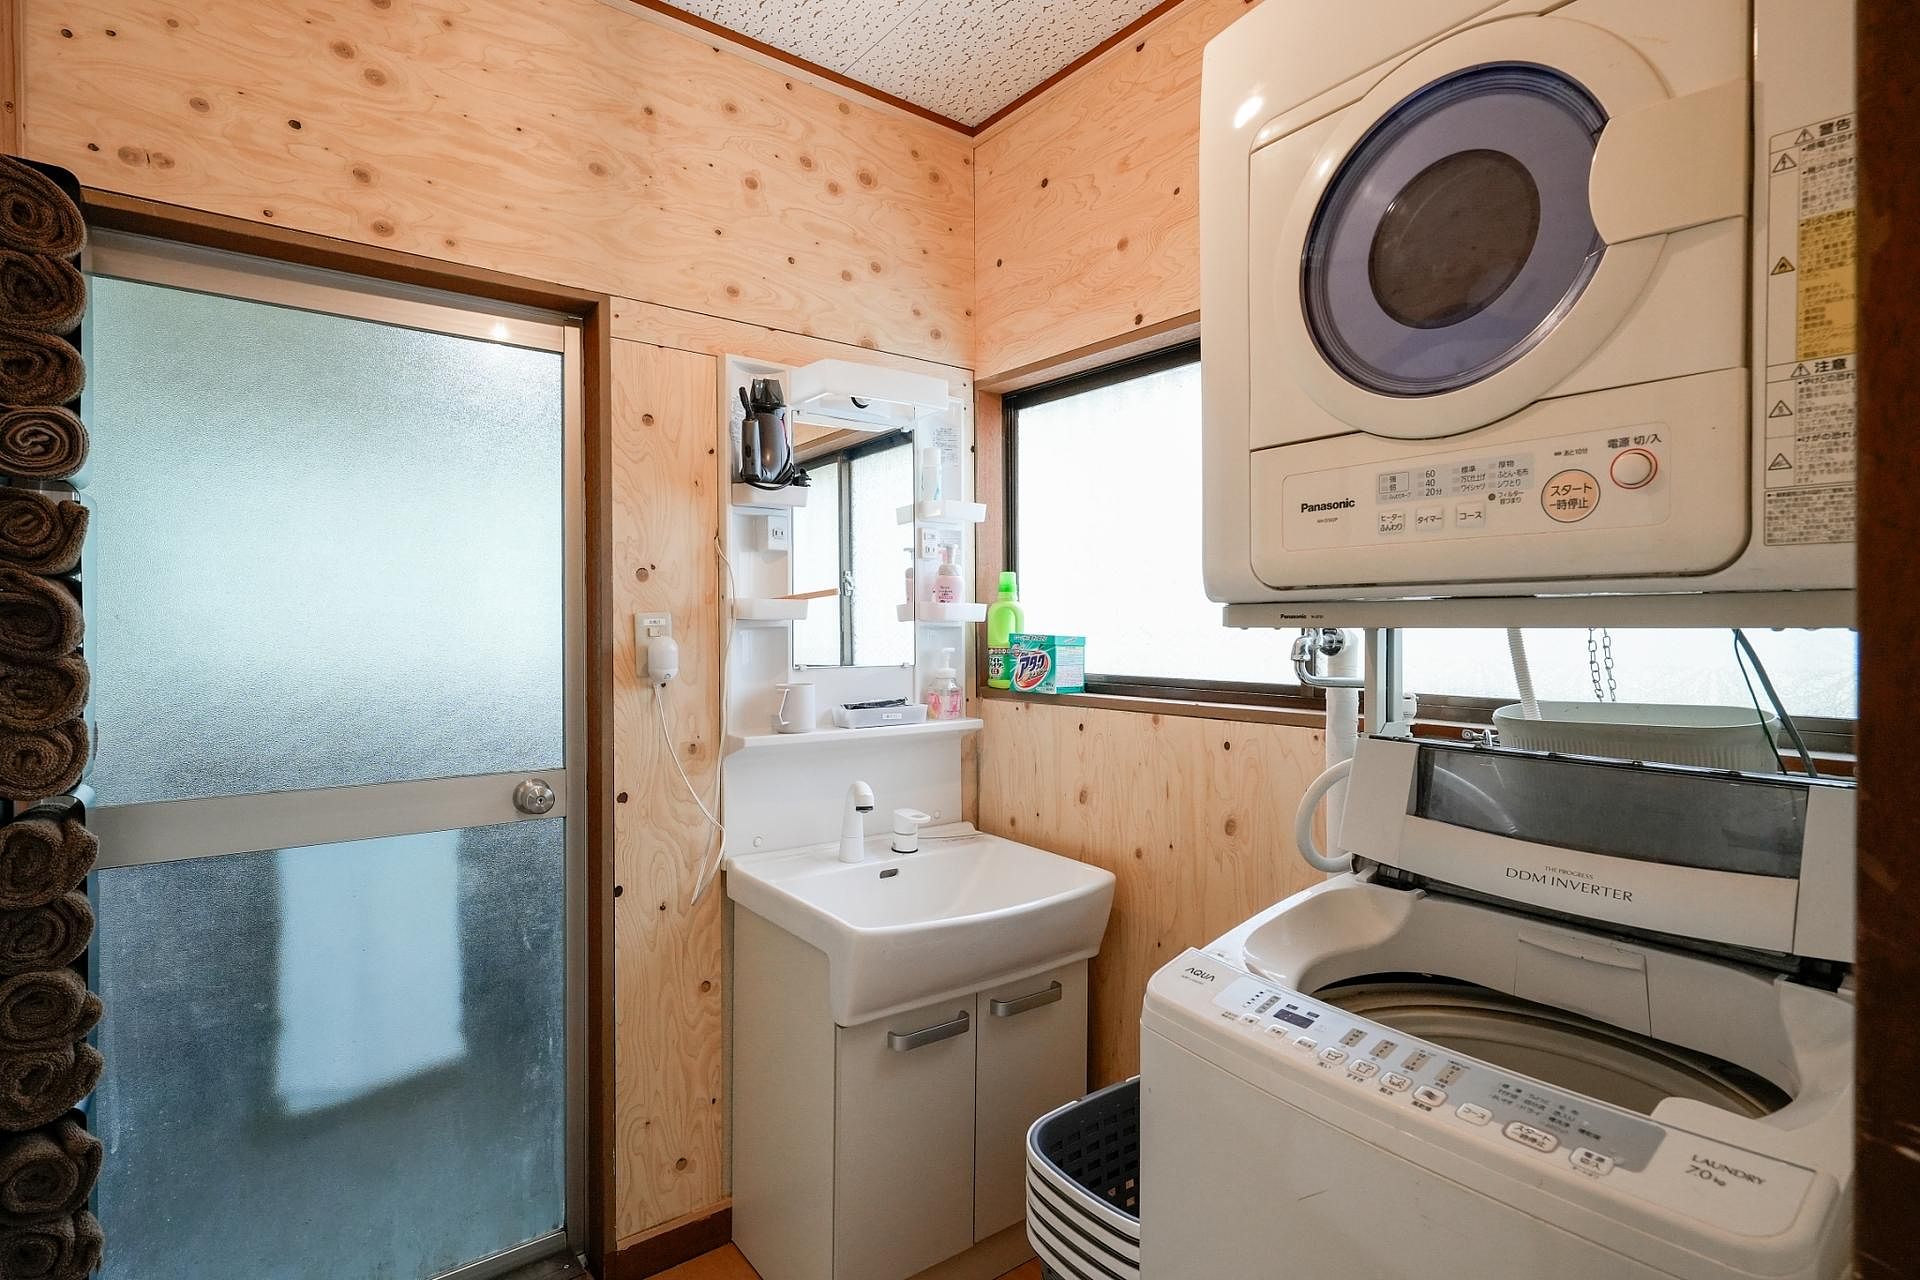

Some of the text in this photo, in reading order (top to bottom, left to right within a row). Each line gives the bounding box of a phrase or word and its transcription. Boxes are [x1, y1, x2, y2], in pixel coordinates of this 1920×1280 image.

[1815, 358, 1847, 373] 注意
[1608, 433, 1662, 449] 電源 切/入
[1425, 469, 1436, 478] 60
[1425, 479, 1435, 487] 40
[1425, 488, 1442, 496] 20分
[1550, 482, 1593, 497] スタート
[1300, 498, 1356, 513] Panasonic
[1549, 497, 1589, 510] 一時停止
[1380, 513, 1403, 522] ヒーター
[1416, 514, 1443, 525] タイマー
[1459, 511, 1483, 521] コース
[1545, 865, 1558, 875] THE
[1505, 867, 1633, 902] DDM INVERTER
[1185, 967, 1215, 982] AQUA
